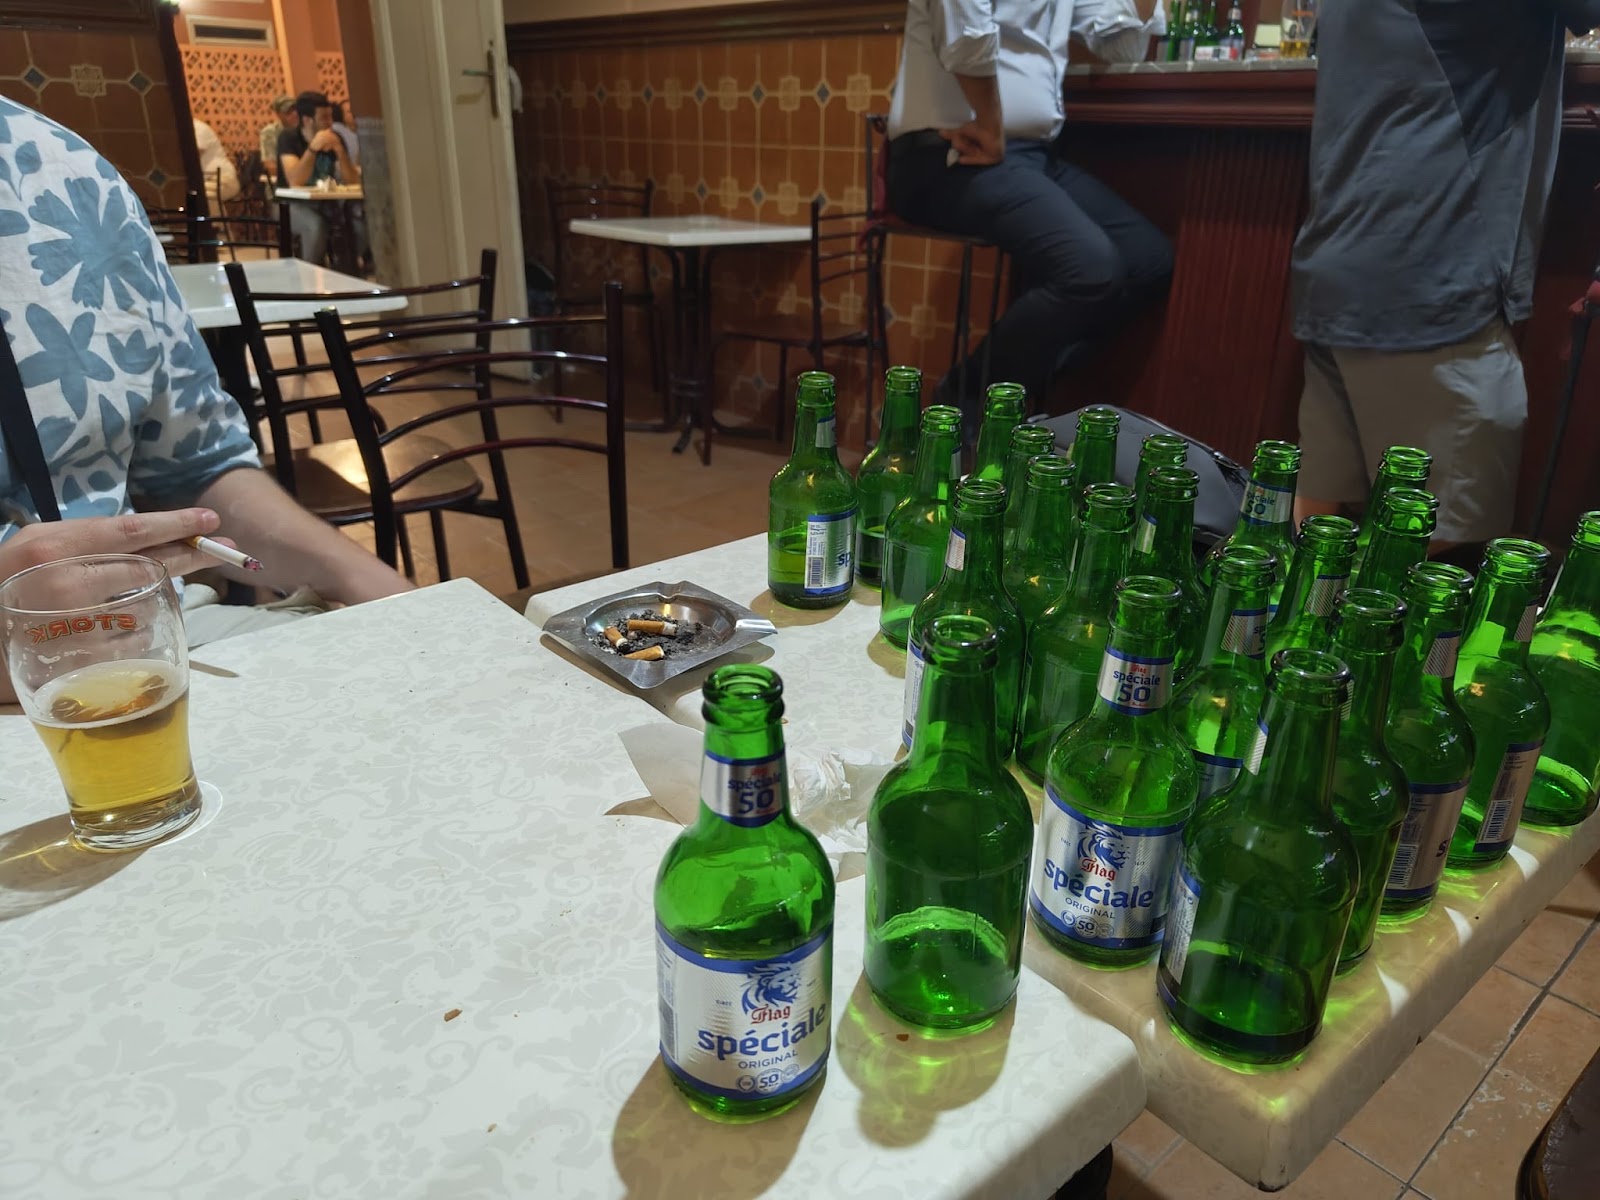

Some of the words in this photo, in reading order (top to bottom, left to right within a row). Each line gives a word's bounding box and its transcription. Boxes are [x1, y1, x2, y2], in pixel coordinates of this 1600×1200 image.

[1113, 670, 1160, 686] spéciale
[1117, 683, 1151, 702] 50
[738, 789, 774, 814] 50
[1081, 858, 1116, 881] Flag
[1044, 858, 1154, 909] spéciale
[1065, 897, 1116, 919] ORIGINAL
[1077, 920, 1095, 931] 50
[751, 1004, 791, 1024] Flag
[697, 1003, 826, 1061] spéciale
[738, 1050, 798, 1070] ORIGINAL
[759, 1074, 779, 1088] 50
